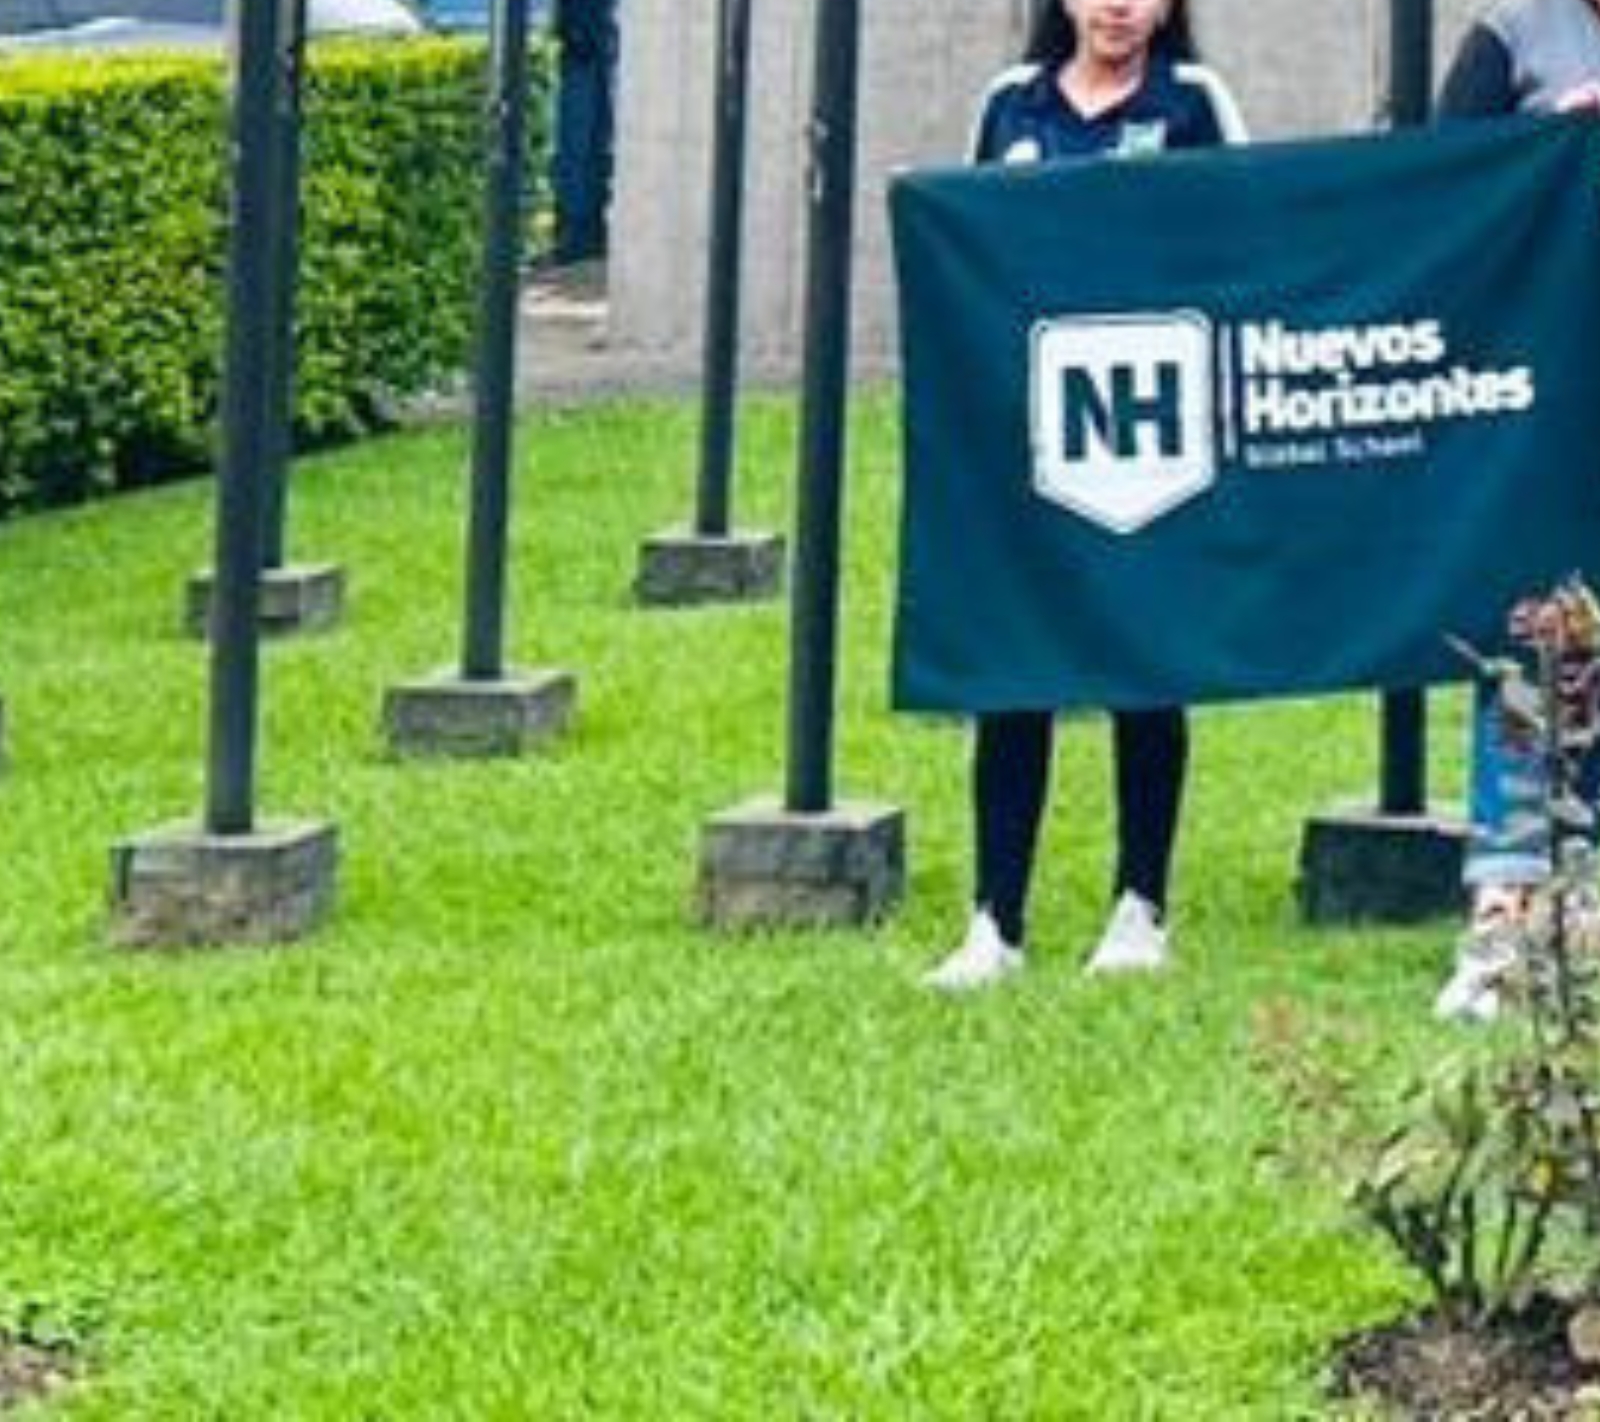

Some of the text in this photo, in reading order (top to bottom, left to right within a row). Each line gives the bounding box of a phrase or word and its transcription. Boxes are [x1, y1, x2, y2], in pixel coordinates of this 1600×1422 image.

[1241, 319, 1446, 375] Nuevos
[1060, 359, 1185, 462] NH
[1245, 363, 1536, 435] Horizontes
